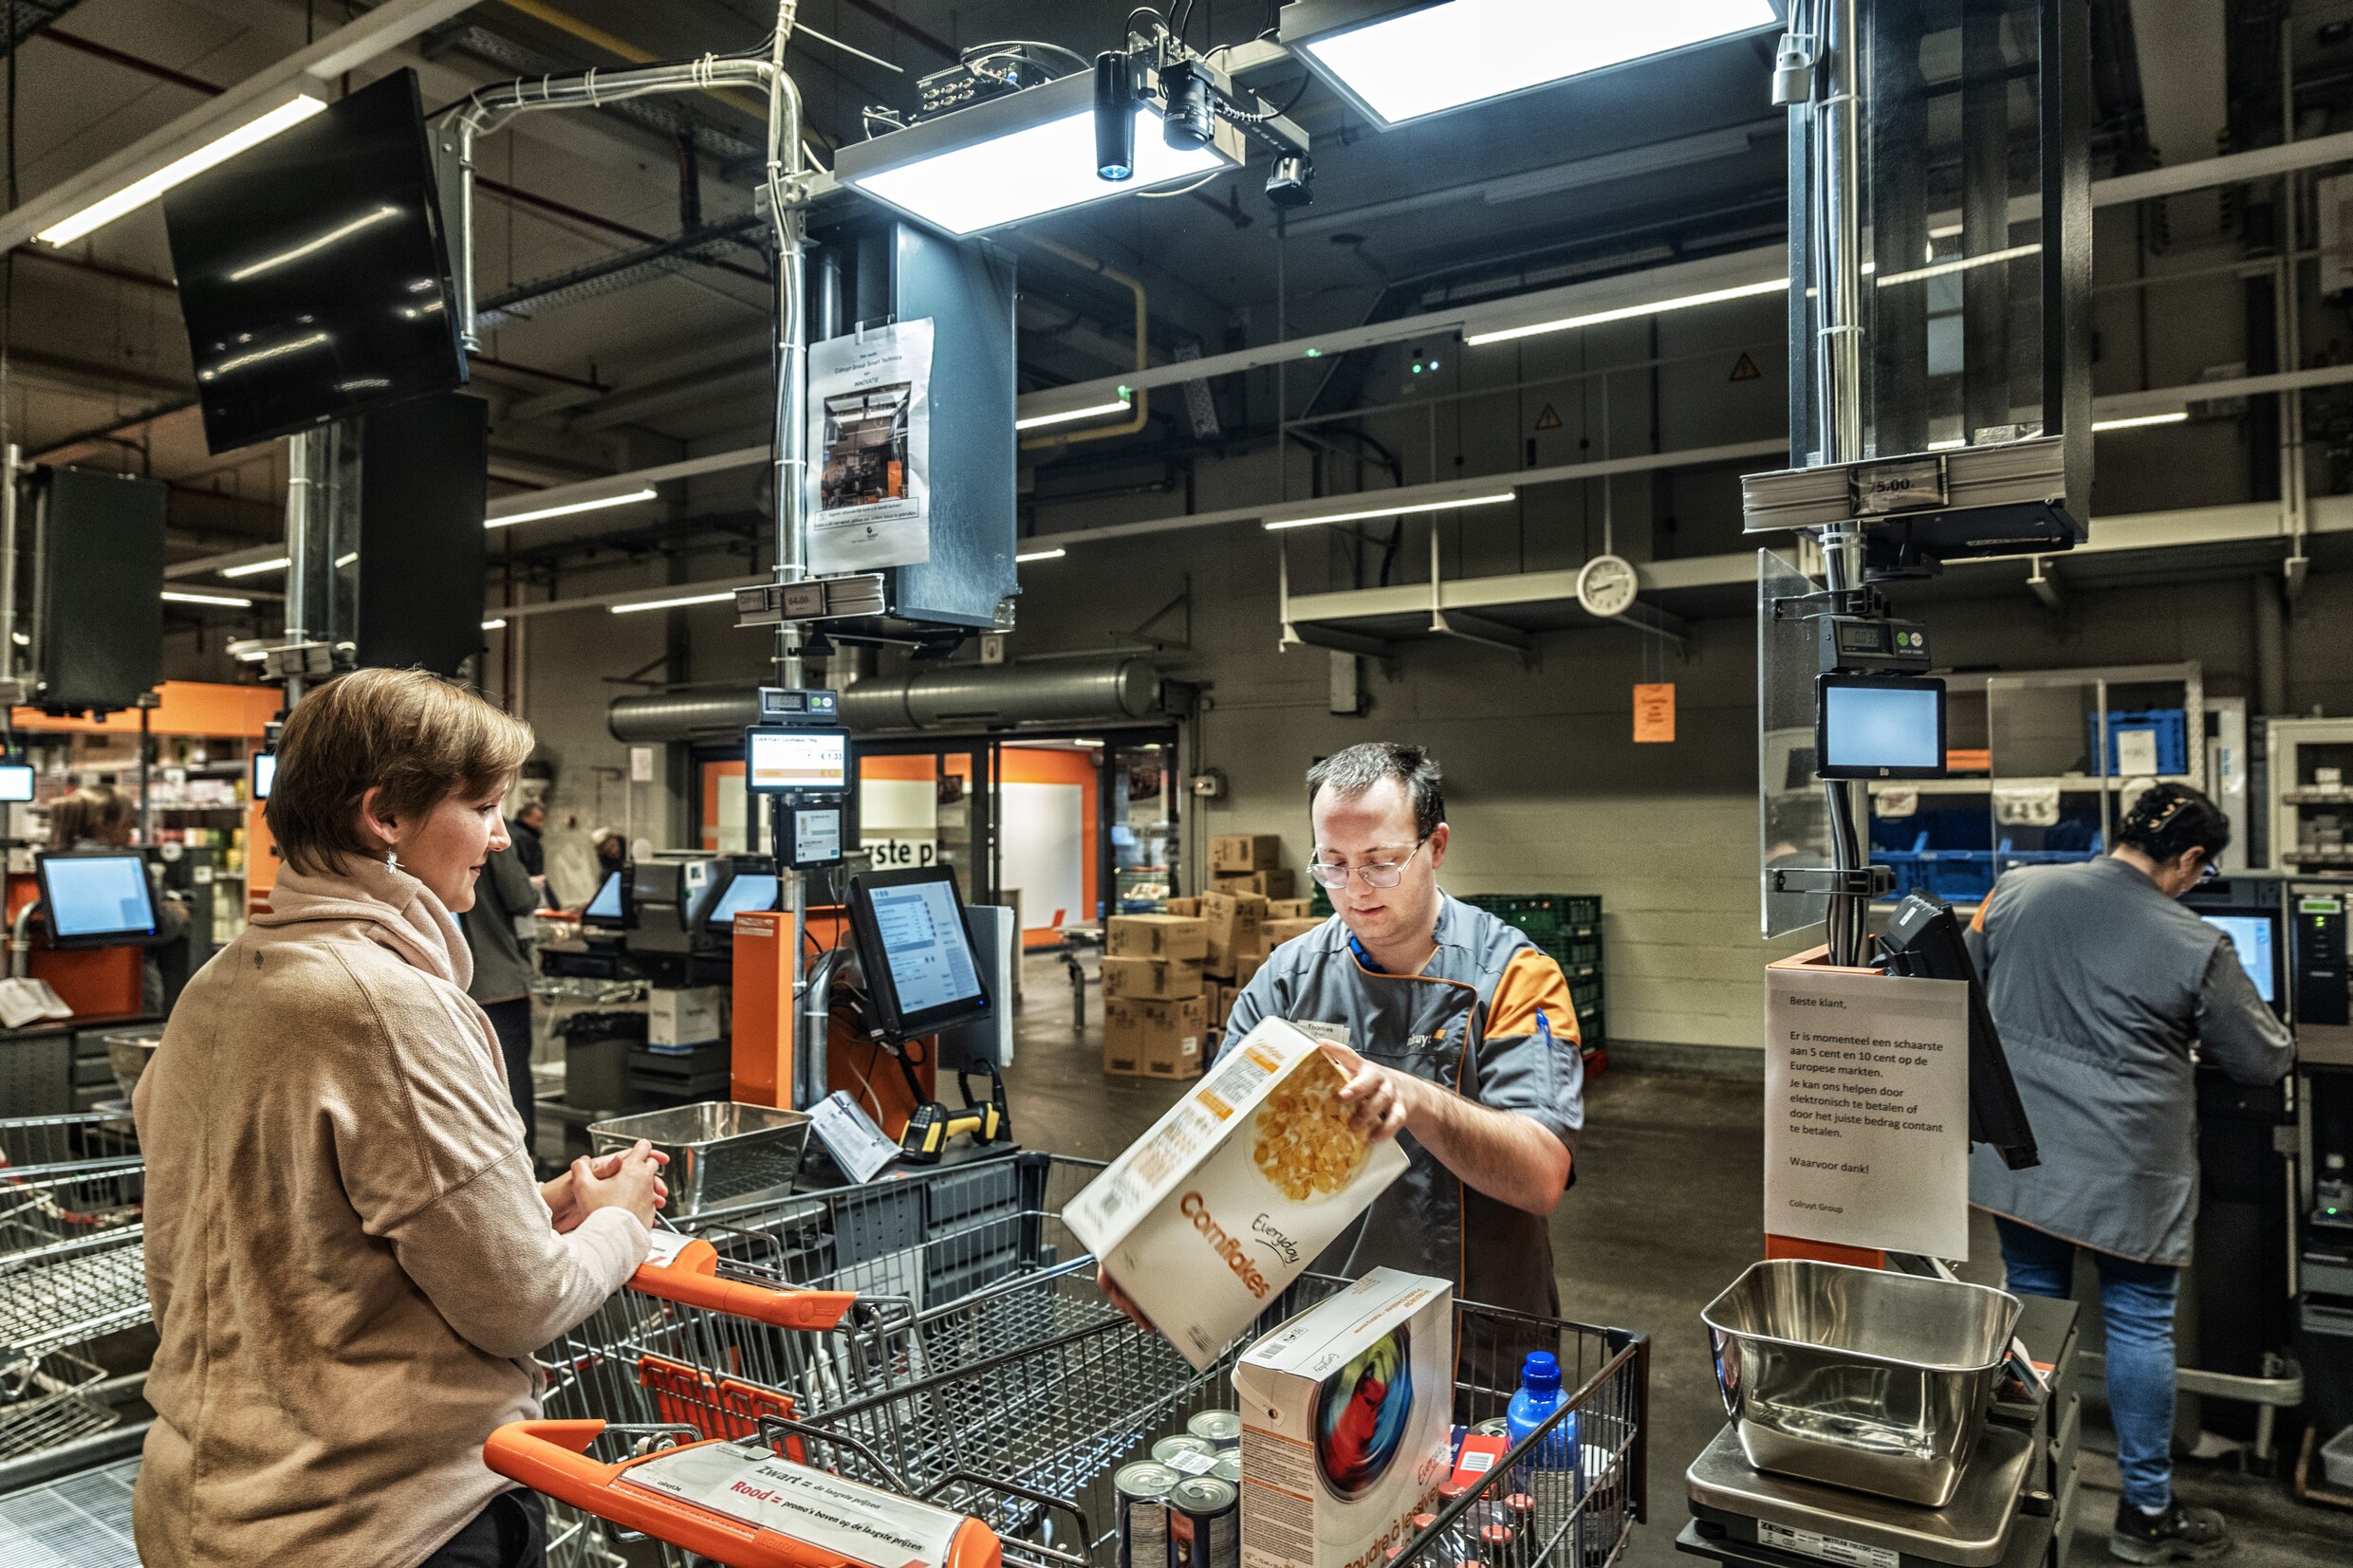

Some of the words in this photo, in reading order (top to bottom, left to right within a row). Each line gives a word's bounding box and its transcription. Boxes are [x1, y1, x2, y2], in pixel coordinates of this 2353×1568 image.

[852, 361, 866, 371] Group
[867, 359, 880, 367] Smart
[1789, 996, 1817, 1006] Beste
[1819, 999, 1846, 1010] klant,
[1307, 1024, 1334, 1033] Thomas
[1790, 1031, 1800, 1041] Er
[1803, 1032, 1810, 1042] is
[1813, 1035, 1869, 1046] momenteel
[1872, 1039, 1891, 1047] een
[1894, 1040, 1943, 1052] schaarste
[1790, 1047, 1807, 1057] aan
[1810, 1047, 1817, 1057] 5
[1819, 1049, 1841, 1059] cent
[1859, 1051, 1871, 1061] 10
[1873, 1053, 1896, 1063] cent
[1899, 1056, 1912, 1066] op
[1915, 1056, 1928, 1066] de
[1790, 1061, 1836, 1075] Europese
[1838, 1065, 1883, 1078] markten.
[1789, 1079, 1800, 1088] Je
[1803, 1079, 1820, 1089] kan
[1823, 1082, 1841, 1091] ons
[1843, 1083, 1877, 1096] helpen
[1880, 1086, 1904, 1098] door
[1789, 1094, 1850, 1108] elektronisch
[1852, 1100, 1862, 1109] te
[1865, 1101, 1903, 1113] betalen
[1906, 1104, 1918, 1115] of
[1789, 1109, 1813, 1119] door
[1815, 1111, 1832, 1121] het
[1834, 1113, 1862, 1125] juiste
[1864, 1116, 1900, 1130] bedrag
[1902, 1121, 1943, 1133] contant
[1790, 1125, 1800, 1134] te
[1803, 1125, 1843, 1138] betalen.
[1789, 1156, 1838, 1171] Waarvoor
[1841, 1162, 1869, 1174] dank!
[1788, 1199, 1817, 1211] Colruyt
[1818, 1203, 1843, 1214] Group
[1180, 1190, 1271, 1300] Cornflakes
[1251, 1212, 1301, 1265] Everyday
[1314, 1353, 1340, 1373] Everyday
[658, 1480, 682, 1492] colruyt.be
[755, 1465, 801, 1485] Zwart
[825, 1486, 852, 1503] laagste
[852, 1495, 881, 1510] prijzen
[730, 1480, 773, 1503] Rood
[781, 1499, 815, 1517] promo's
[814, 1510, 839, 1524] boven
[838, 1519, 850, 1529] op
[851, 1521, 862, 1531] de
[862, 1523, 893, 1543] laagste
[892, 1534, 923, 1552] prijzen
[1391, 1519, 1400, 1541] à
